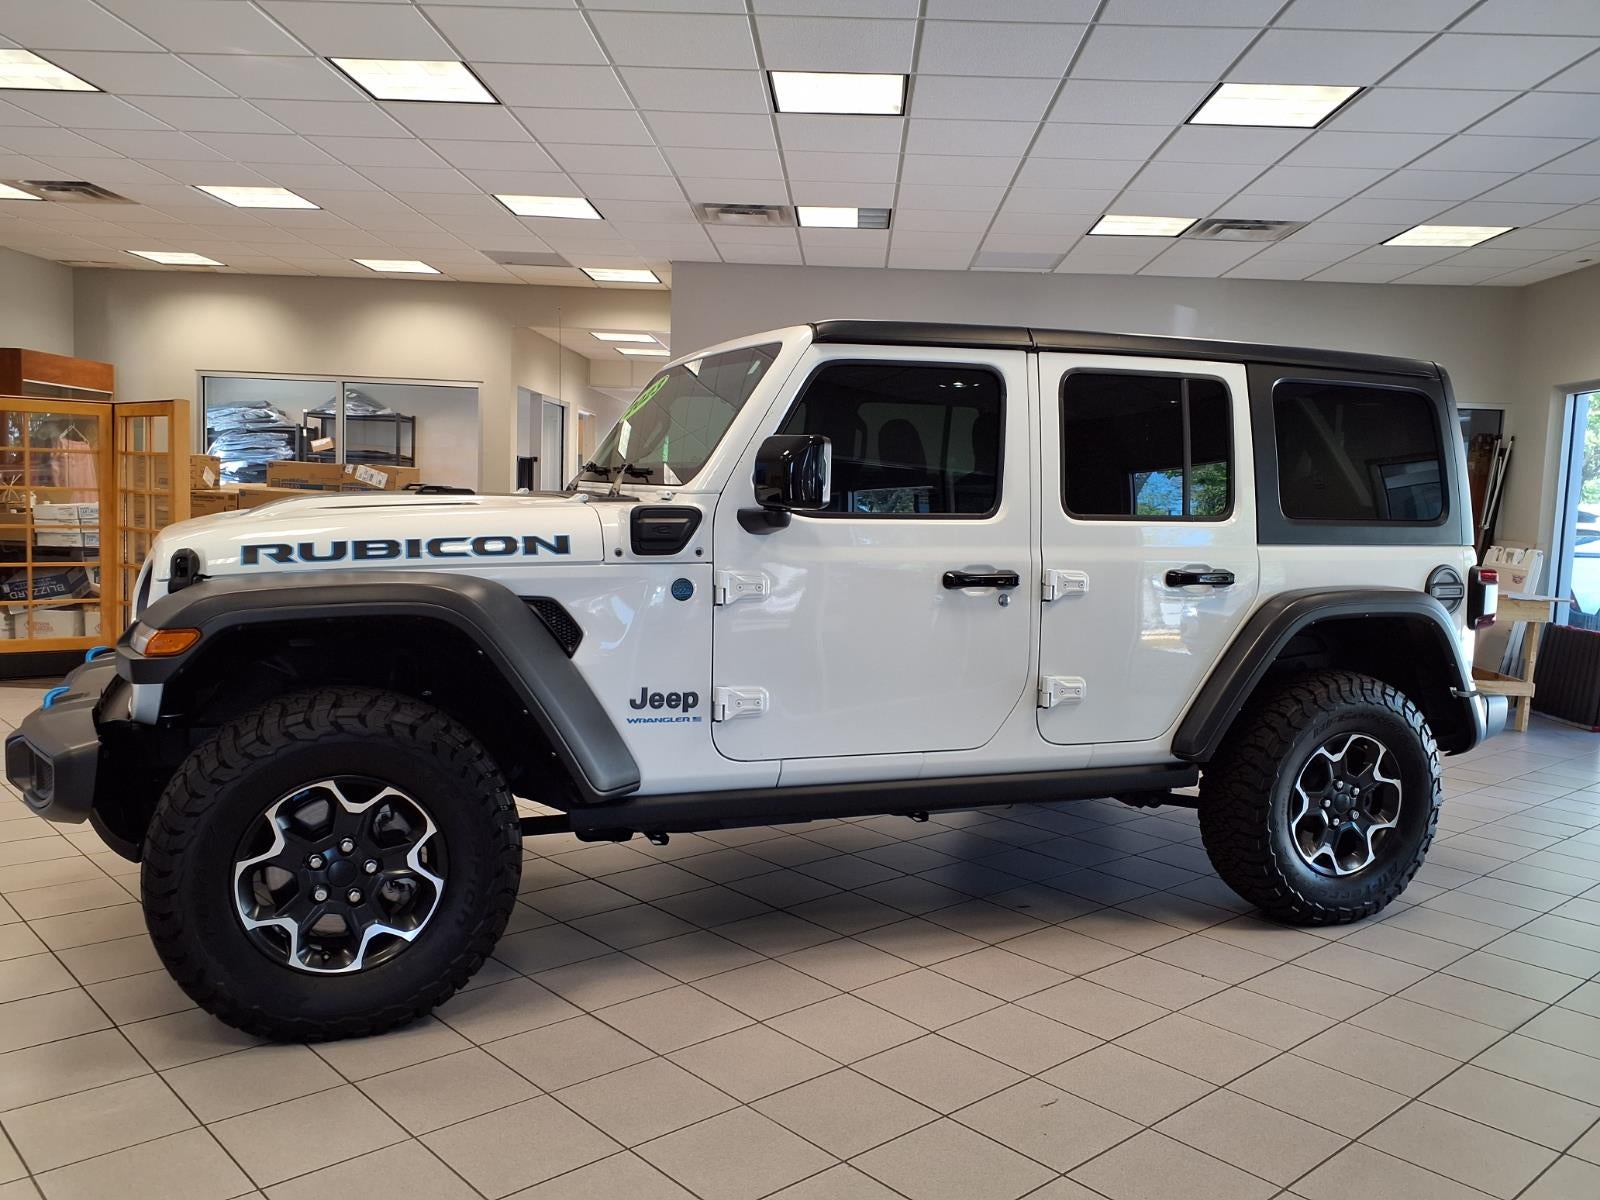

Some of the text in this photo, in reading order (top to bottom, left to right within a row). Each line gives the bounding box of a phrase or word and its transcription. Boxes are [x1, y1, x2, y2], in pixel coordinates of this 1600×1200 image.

[241, 535, 571, 565] RUBICON
[629, 687, 699, 713] Jeep
[626, 716, 690, 724] WRANGLER
